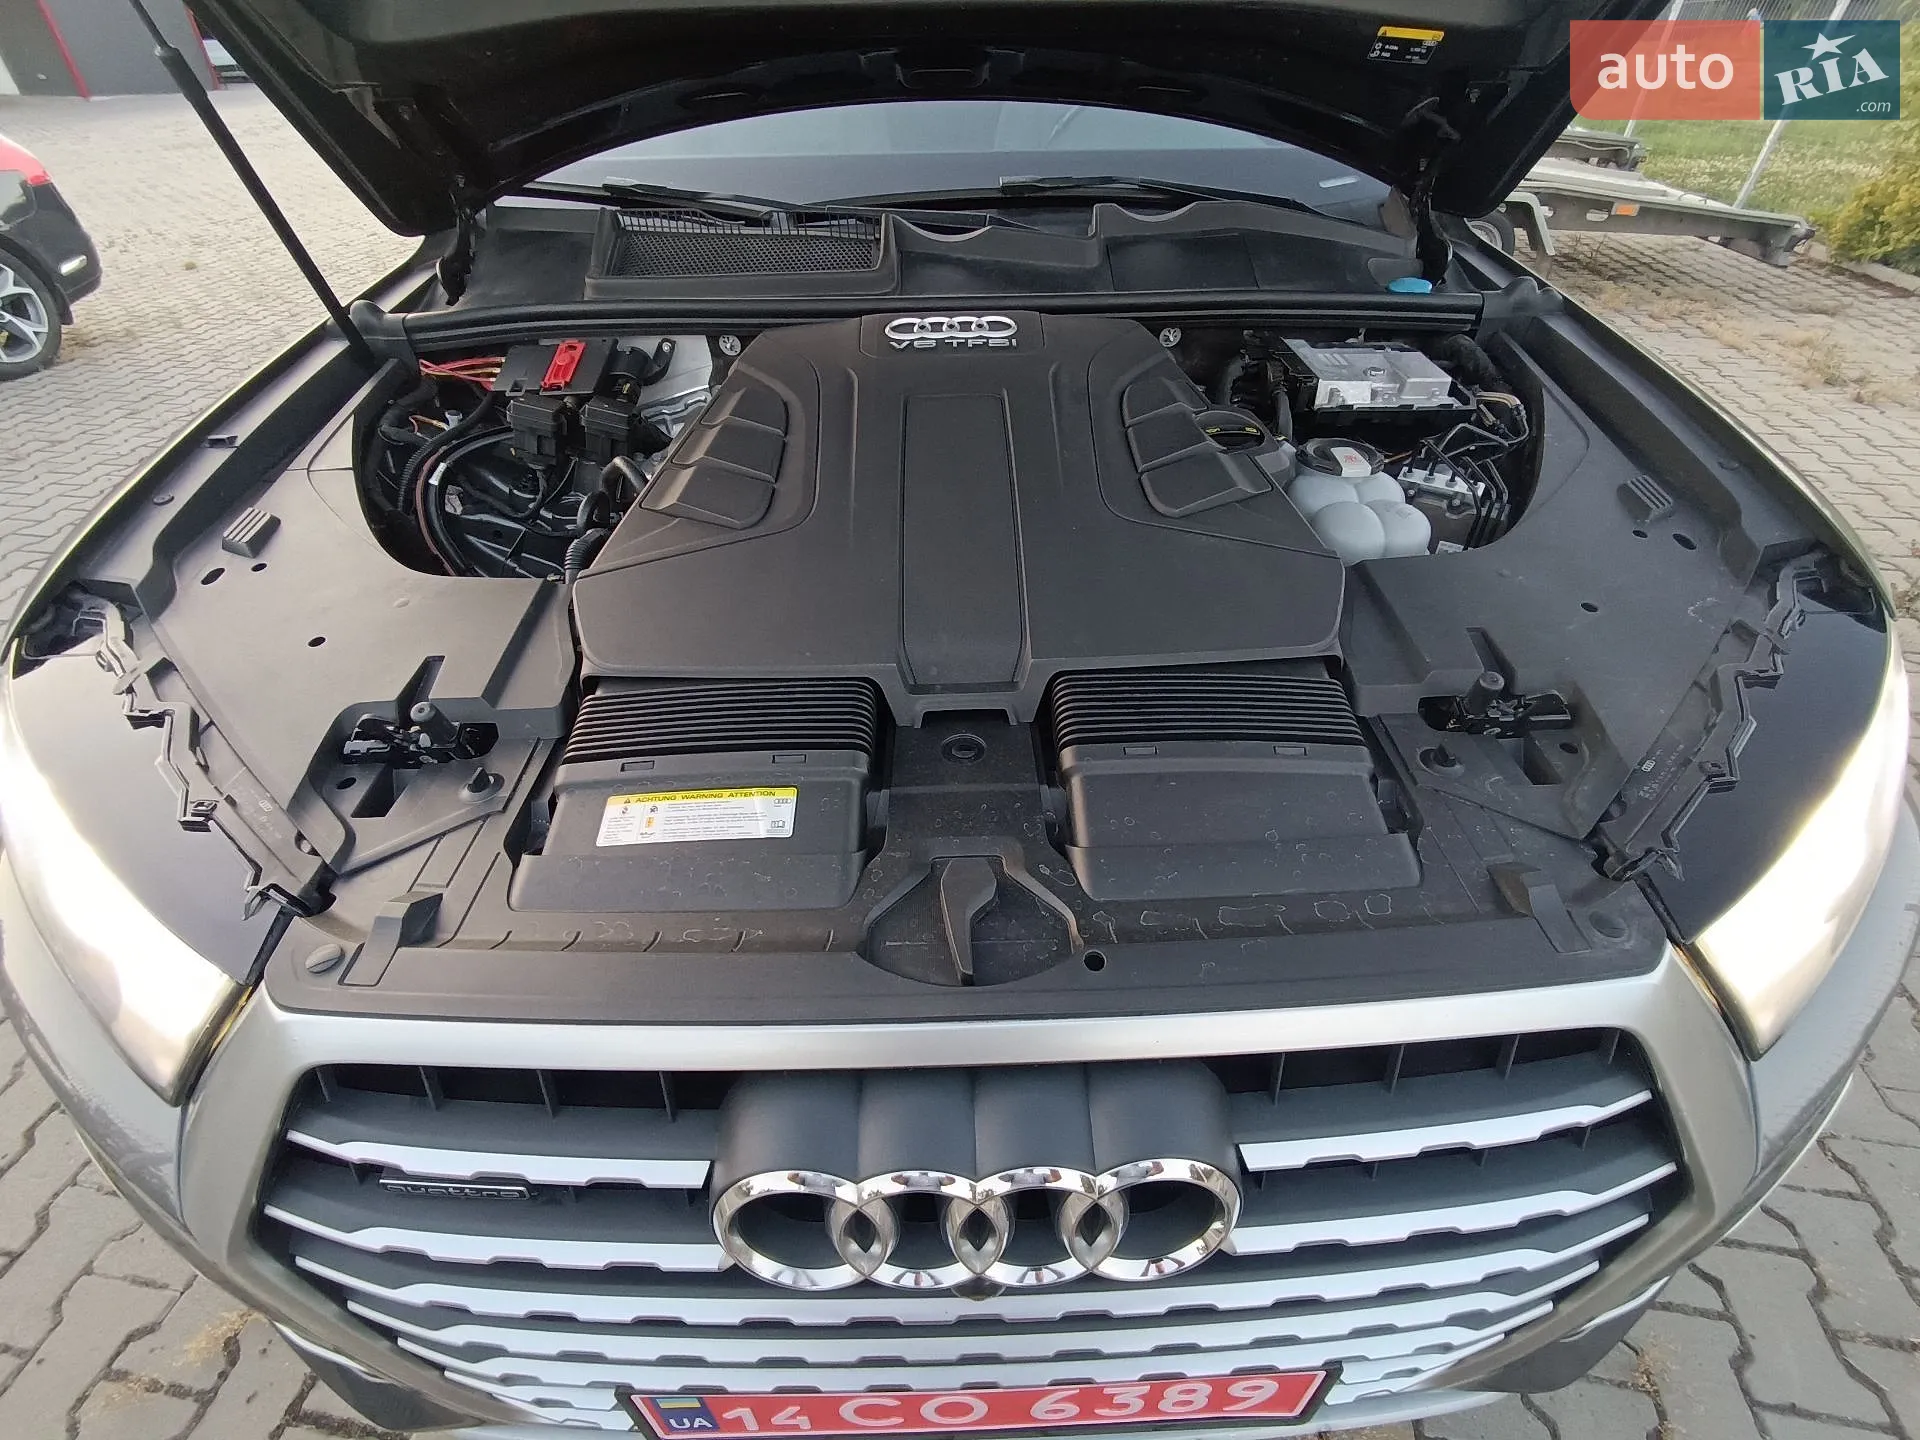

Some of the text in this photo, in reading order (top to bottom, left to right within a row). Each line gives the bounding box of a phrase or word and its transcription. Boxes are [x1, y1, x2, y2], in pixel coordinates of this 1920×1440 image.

[889, 340, 937, 350] V6
[635, 790, 776, 804] ACHTUNG WARNING ATTENTION
[386, 1184, 520, 1199] quattro
[722, 1379, 1280, 1431] 14 CO 6389
[668, 1417, 713, 1429] UA
